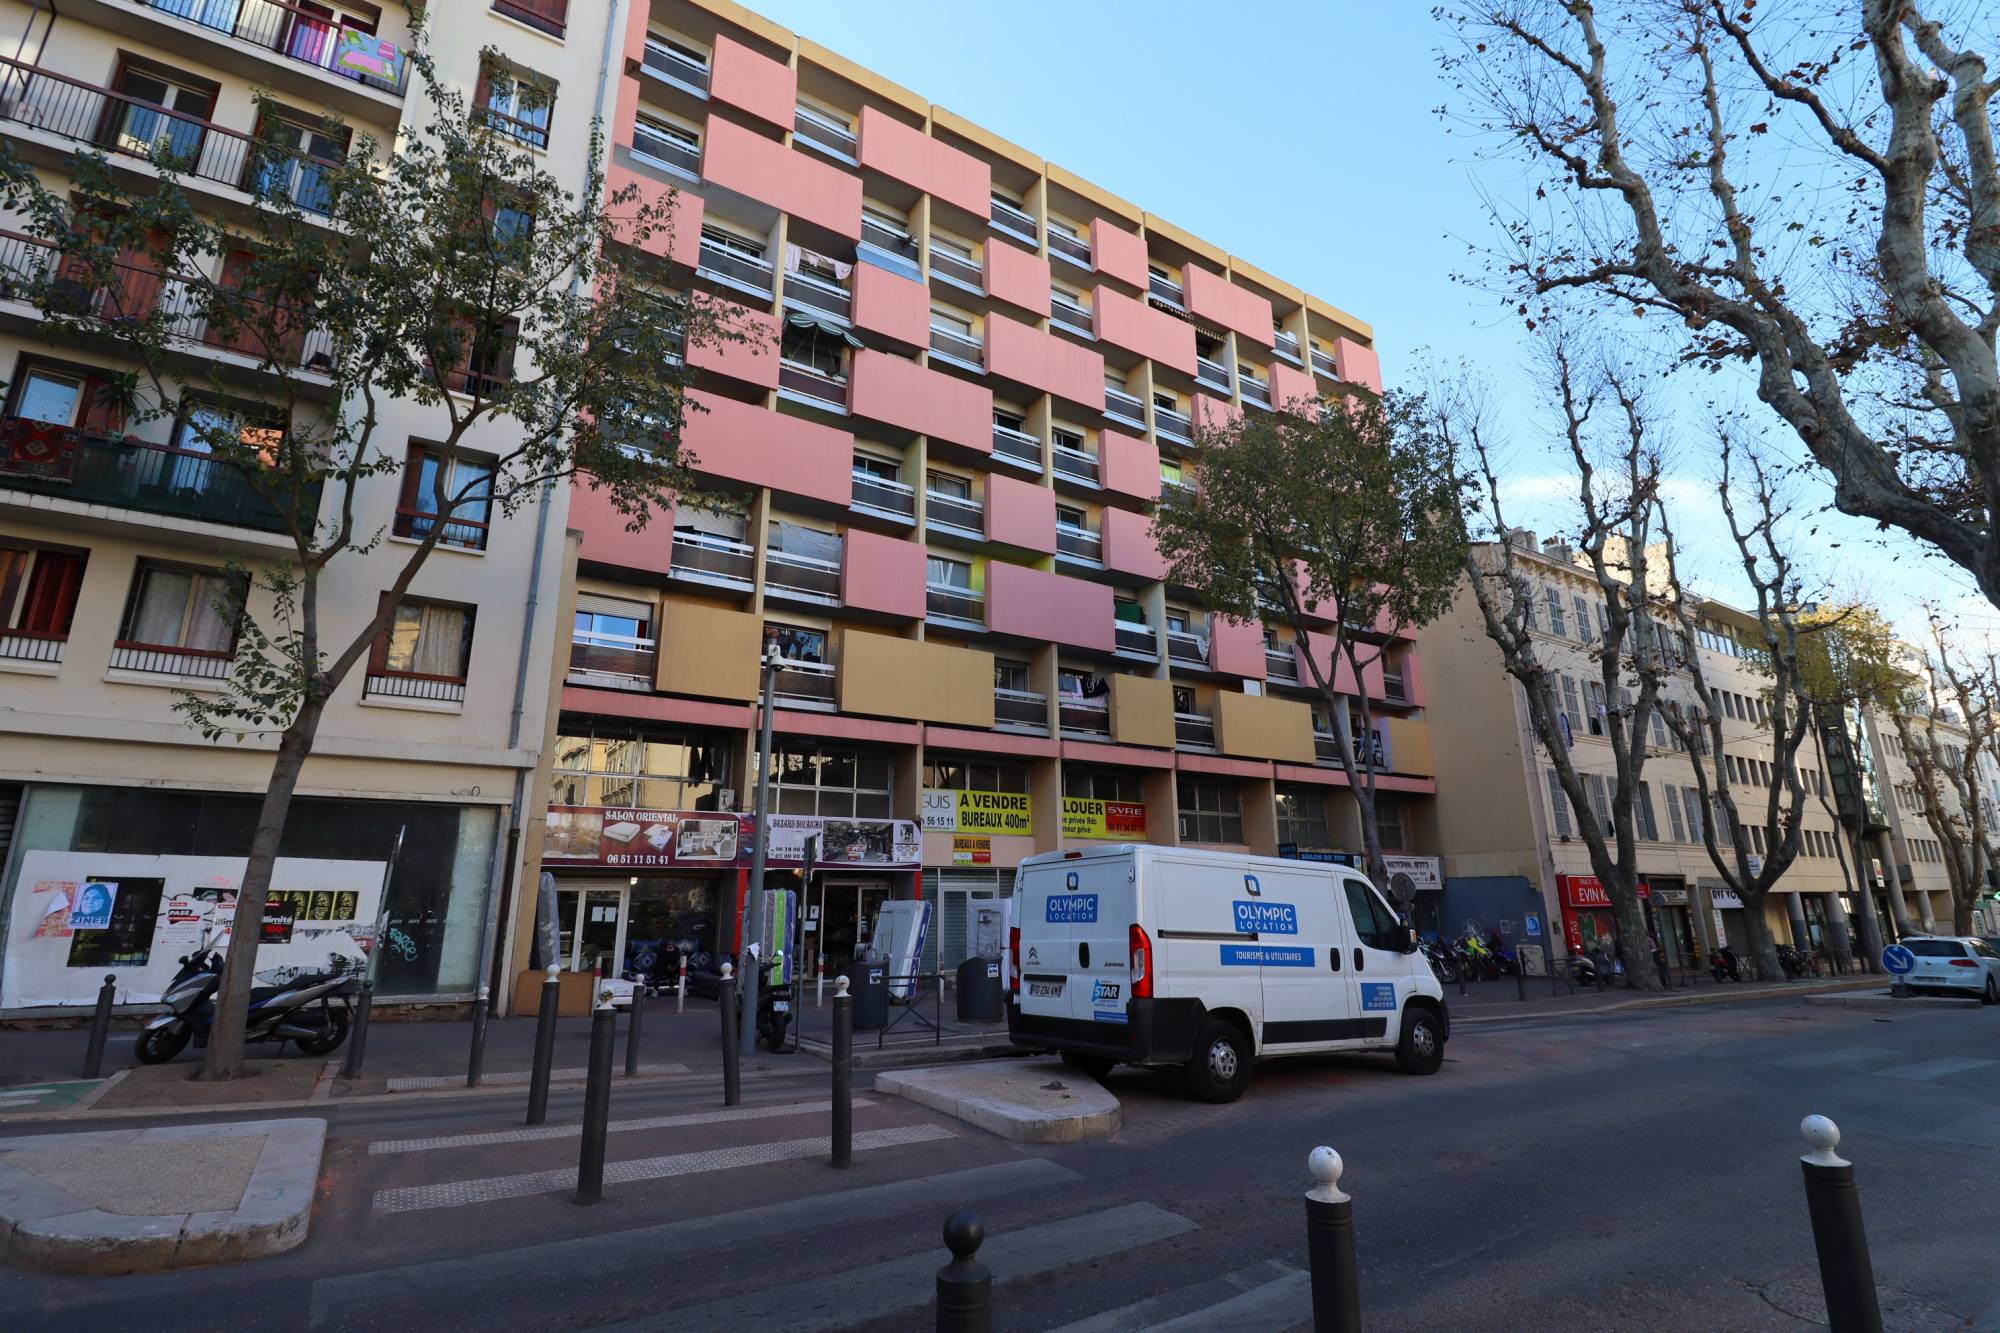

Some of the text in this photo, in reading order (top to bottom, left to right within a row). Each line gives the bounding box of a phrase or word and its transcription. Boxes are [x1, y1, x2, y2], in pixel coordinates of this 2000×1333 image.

[960, 794, 1027, 810] A VENDRE
[1064, 800, 1103, 815] LOUER
[605, 811, 678, 823] SALON ORIENTAL
[1108, 806, 1143, 816] SVRE
[927, 816, 954, 826] 56 15 11
[961, 811, 1003, 828] BUREAUX
[620, 854, 631, 864] 51
[634, 855, 643, 864] 11
[646, 855, 656, 864] 51
[659, 855, 669, 865] 41
[1579, 888, 1599, 902] EVIN
[1049, 898, 1094, 911] OLYMPIC
[1050, 912, 1094, 920] LOCATION
[1238, 905, 1292, 922] OLYMPIC
[70, 916, 108, 925] ZINEB
[1240, 921, 1293, 931] LOCATION
[1236, 951, 1302, 961] TOURISME & UTILITAIRES
[1094, 986, 1118, 998] STAR
